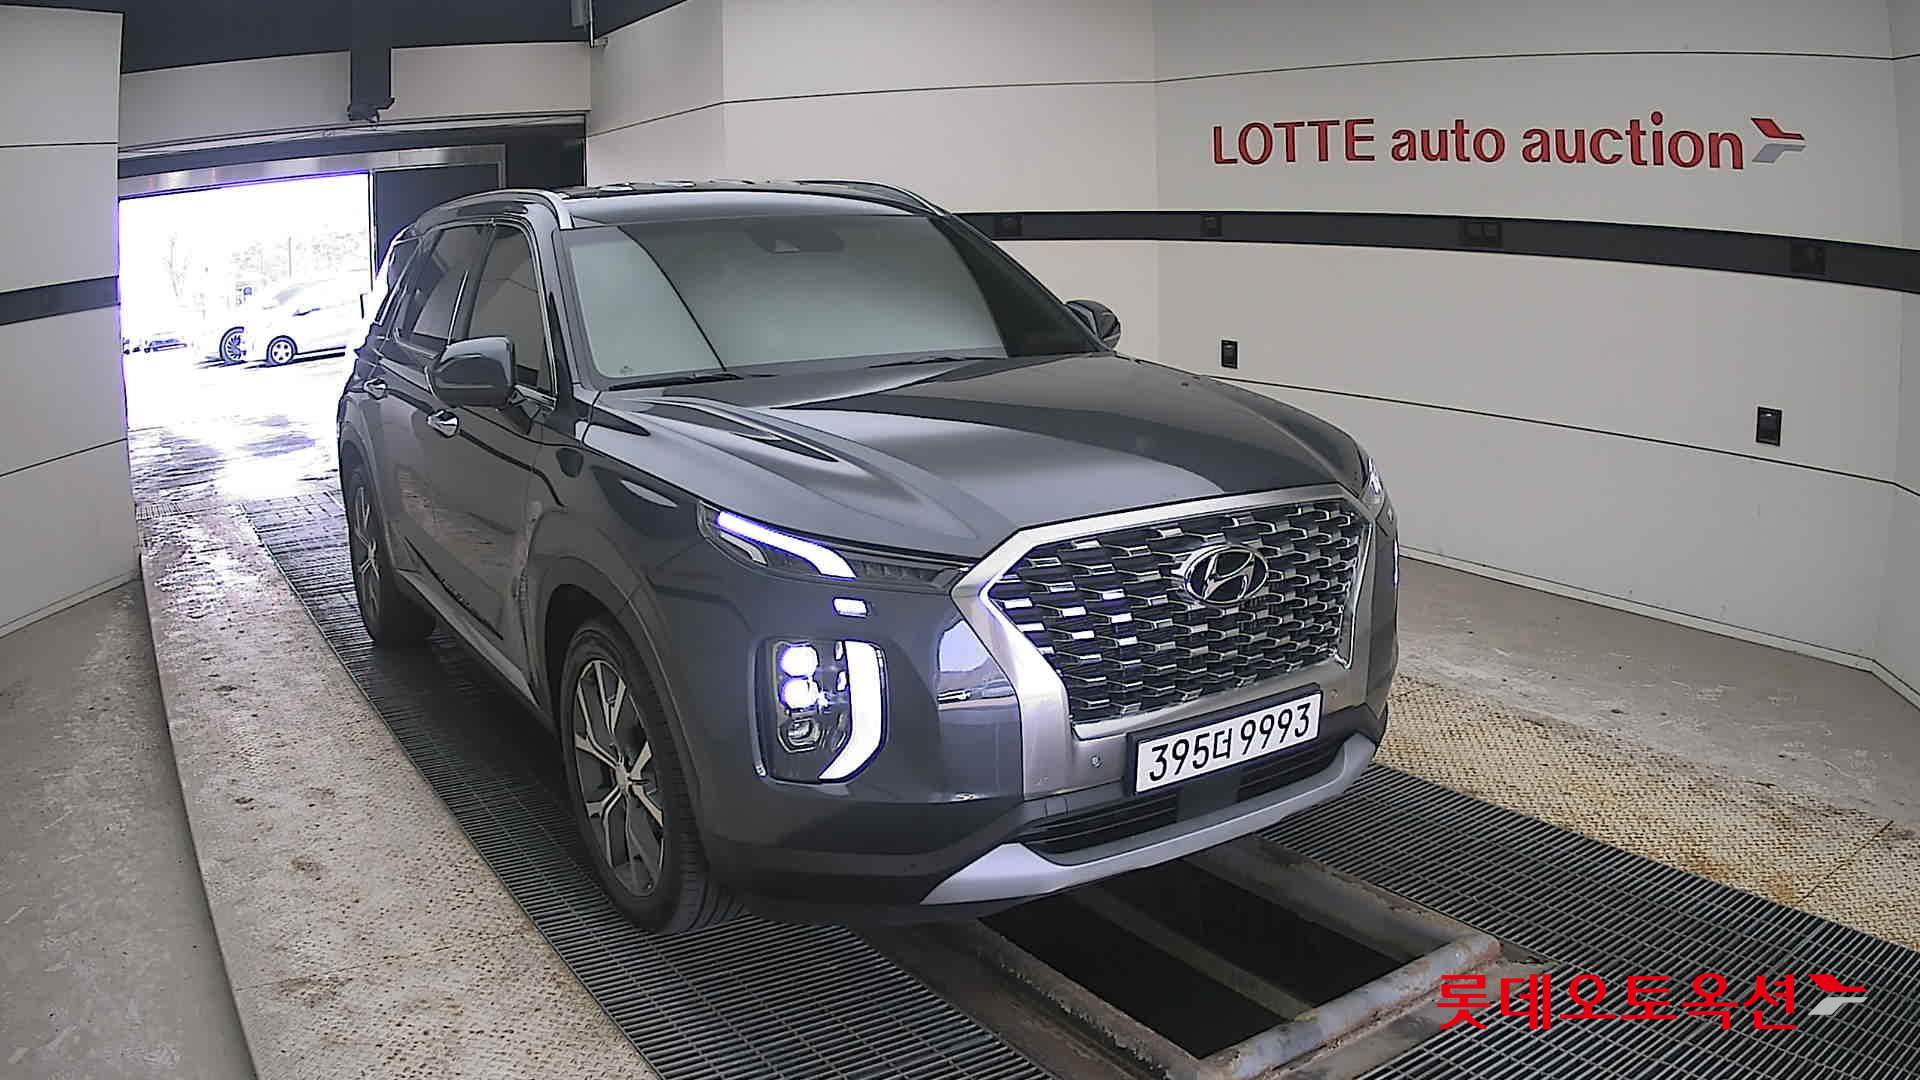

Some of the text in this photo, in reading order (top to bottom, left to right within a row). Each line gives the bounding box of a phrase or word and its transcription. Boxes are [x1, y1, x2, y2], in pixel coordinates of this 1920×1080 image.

[1212, 111, 1744, 170] LOTTE auto auction
[1149, 702, 1312, 782] 395더 9993
